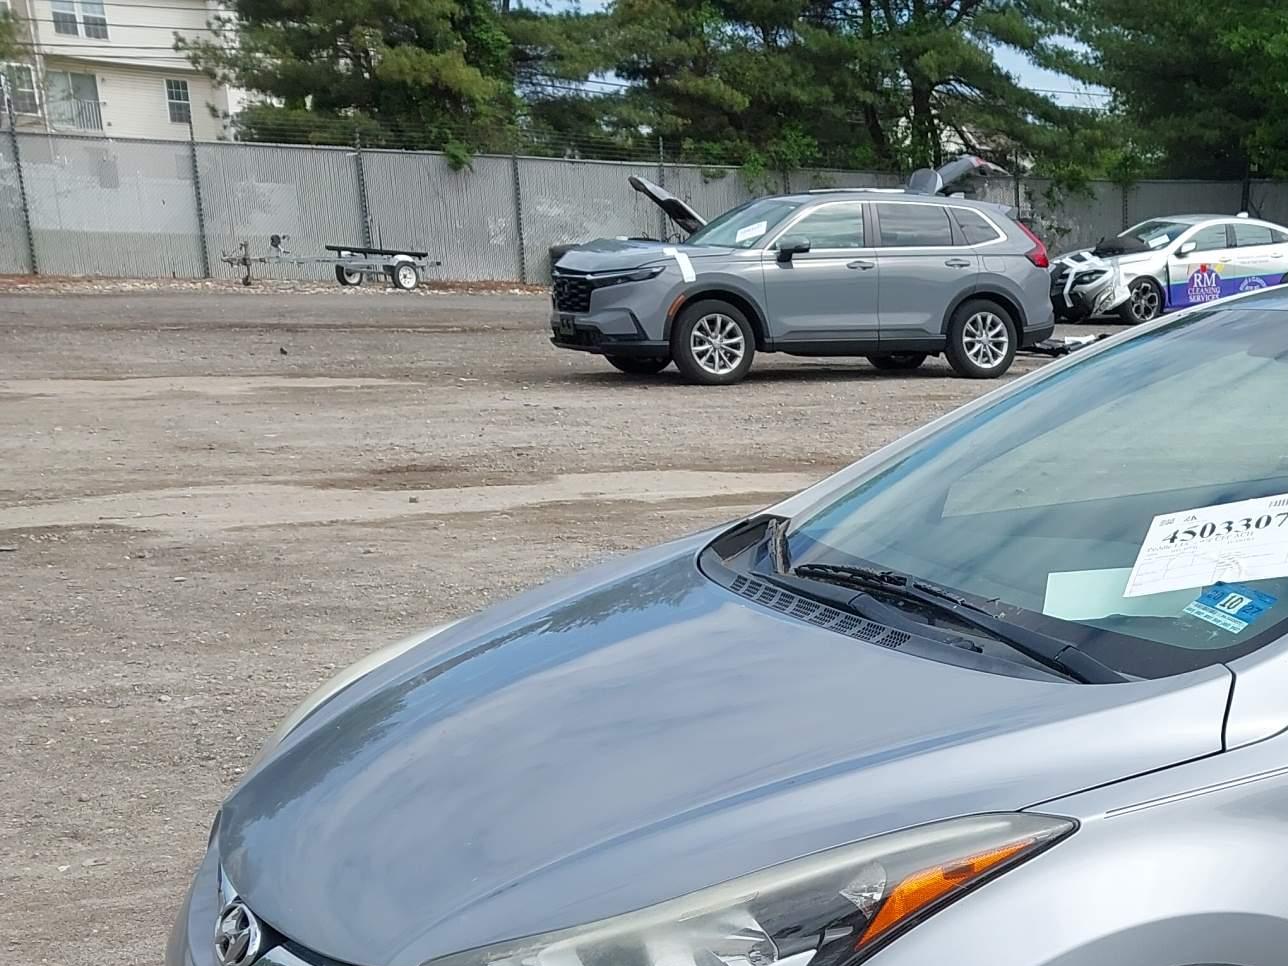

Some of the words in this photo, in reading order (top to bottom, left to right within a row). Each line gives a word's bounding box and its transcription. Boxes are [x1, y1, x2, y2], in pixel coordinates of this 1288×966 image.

[1193, 272, 1217, 288] RM
[1188, 287, 1221, 295] CLEANING
[1189, 293, 1220, 302] SERVICES
[1219, 594, 1244, 610] 10
